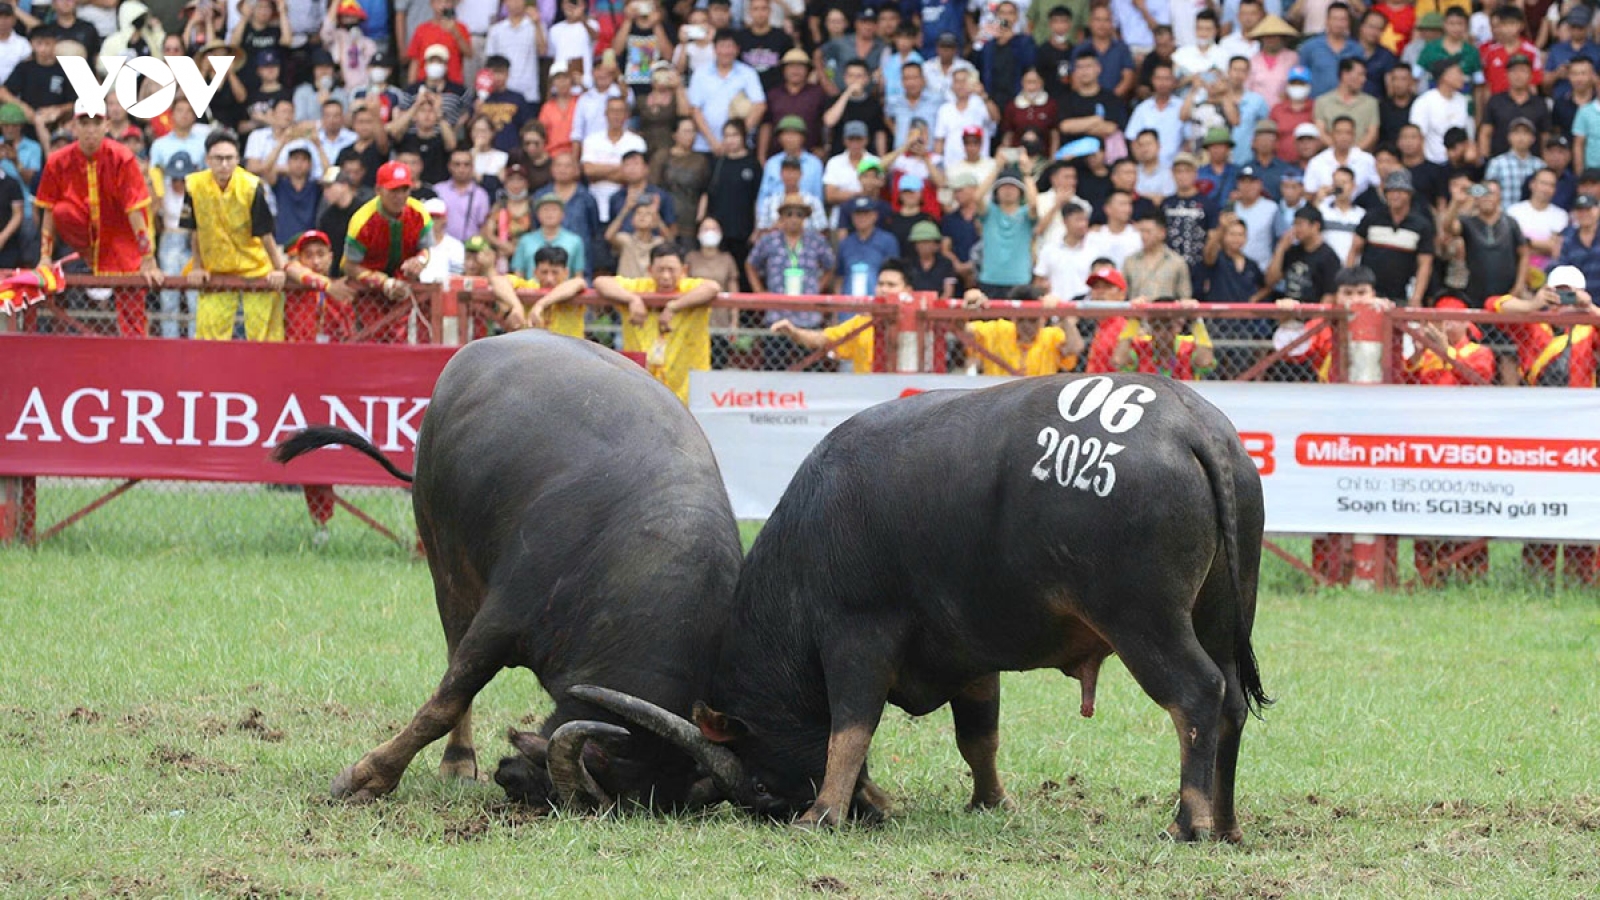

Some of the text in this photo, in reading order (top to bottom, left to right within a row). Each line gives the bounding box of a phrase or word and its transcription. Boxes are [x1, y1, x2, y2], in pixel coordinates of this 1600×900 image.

[711, 387, 808, 409] viettel
[1057, 376, 1157, 434] 06
[6, 386, 430, 452] AGRIBANK
[749, 412, 809, 426] telecom
[1031, 426, 1127, 497] 2025
[1307, 436, 1599, 468] Miễn phí TV360 basic 4K
[1337, 496, 1386, 515] Soạn
[1392, 498, 1420, 513] tin:
[1507, 499, 1536, 518] gửi
[1541, 501, 1568, 516] 191
